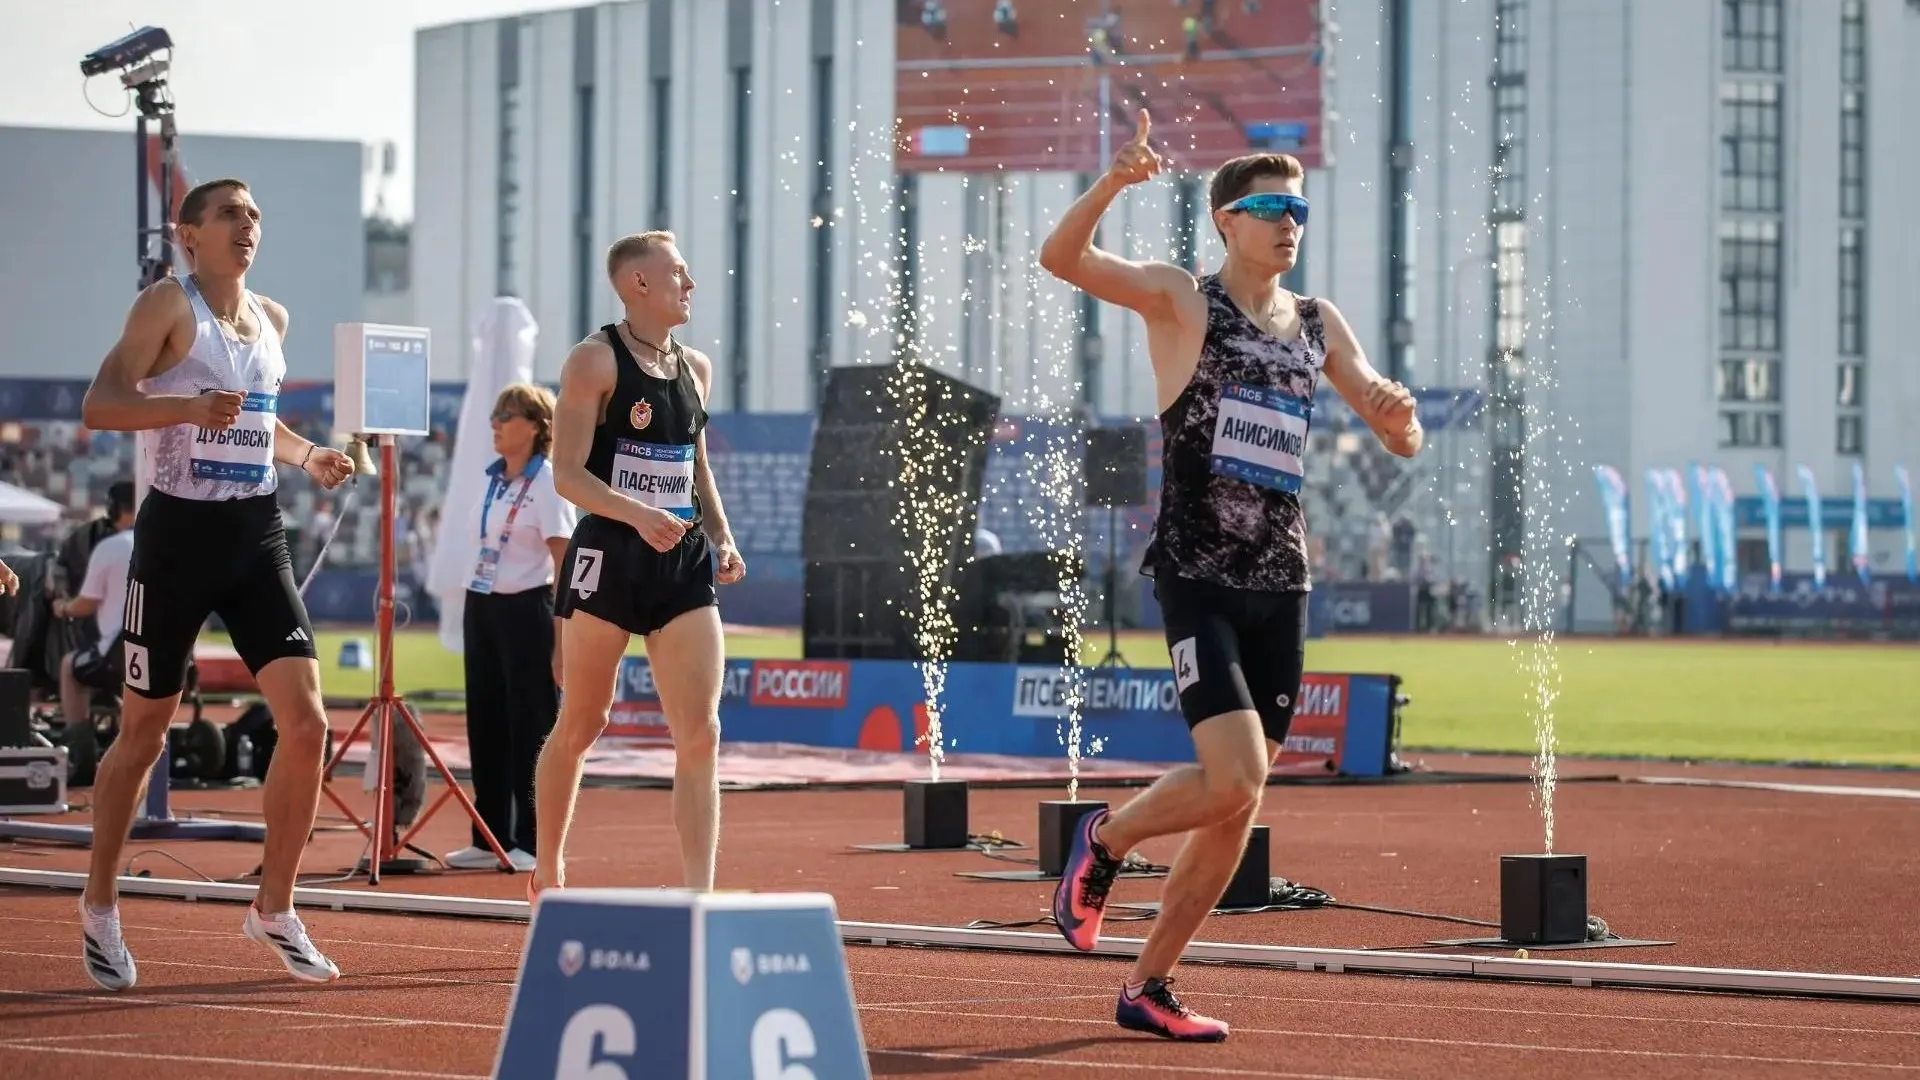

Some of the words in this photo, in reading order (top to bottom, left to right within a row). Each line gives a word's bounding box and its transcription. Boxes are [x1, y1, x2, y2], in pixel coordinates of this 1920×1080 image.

[1238, 387, 1263, 401] ПСБ
[631, 444, 652, 456] ПСБ
[1221, 416, 1302, 458] АНИСИМОВ
[618, 469, 688, 494] ПАСЕЧНИК
[578, 555, 596, 583] 7
[129, 652, 142, 680] 6
[1179, 648, 1191, 680] 4
[756, 668, 843, 699] РОССИИ
[1019, 677, 1067, 707] ПСБ
